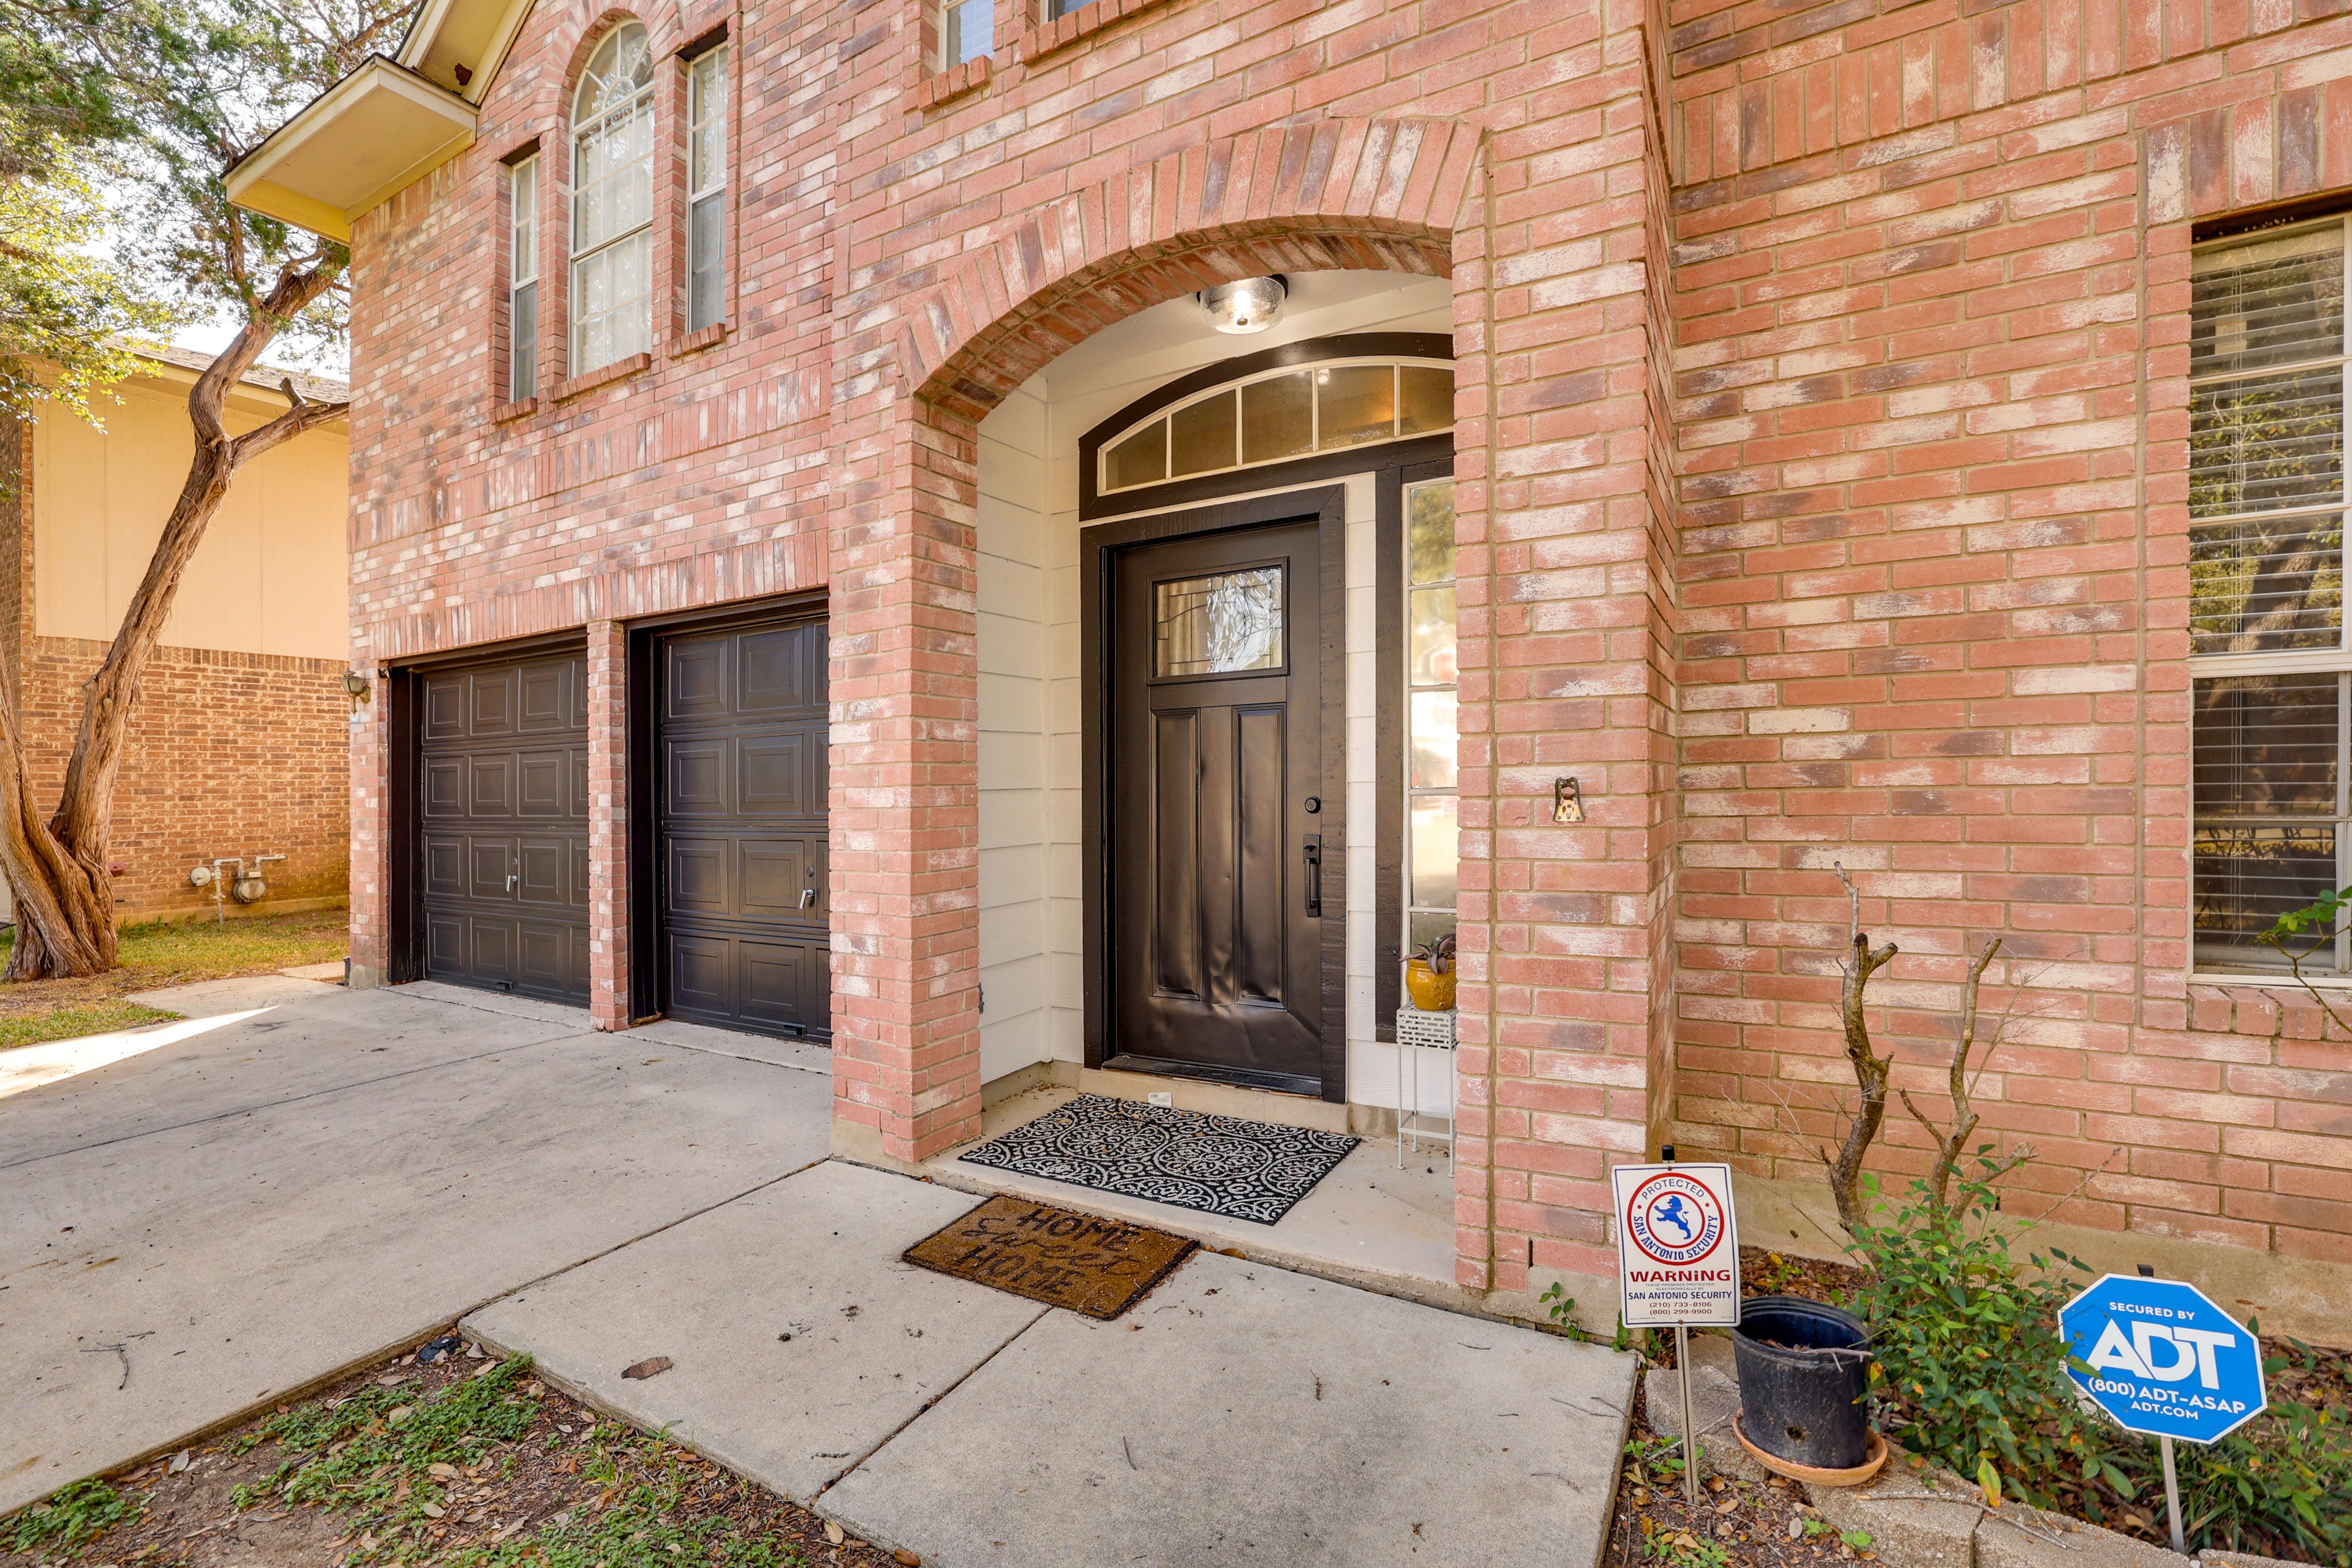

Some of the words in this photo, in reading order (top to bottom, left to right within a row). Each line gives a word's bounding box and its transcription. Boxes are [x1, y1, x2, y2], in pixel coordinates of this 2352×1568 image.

[1642, 1179, 1705, 1199] PROTECTED
[1017, 1208, 1140, 1252] HOME
[1634, 1216, 1647, 1236] SAN
[1641, 1236, 1684, 1261] ANTONIO
[1686, 1215, 1718, 1258] SECURITY
[954, 1245, 1086, 1295] HOME
[2109, 1302, 2173, 1317] SECURED
[2178, 1310, 2195, 1321] BY
[2086, 1318, 2236, 1390] ADT
[2088, 1377, 2136, 1399] (800)
[2139, 1385, 2246, 1414] ADT-ASAP
[2131, 1401, 2199, 1420] ADT.COM
